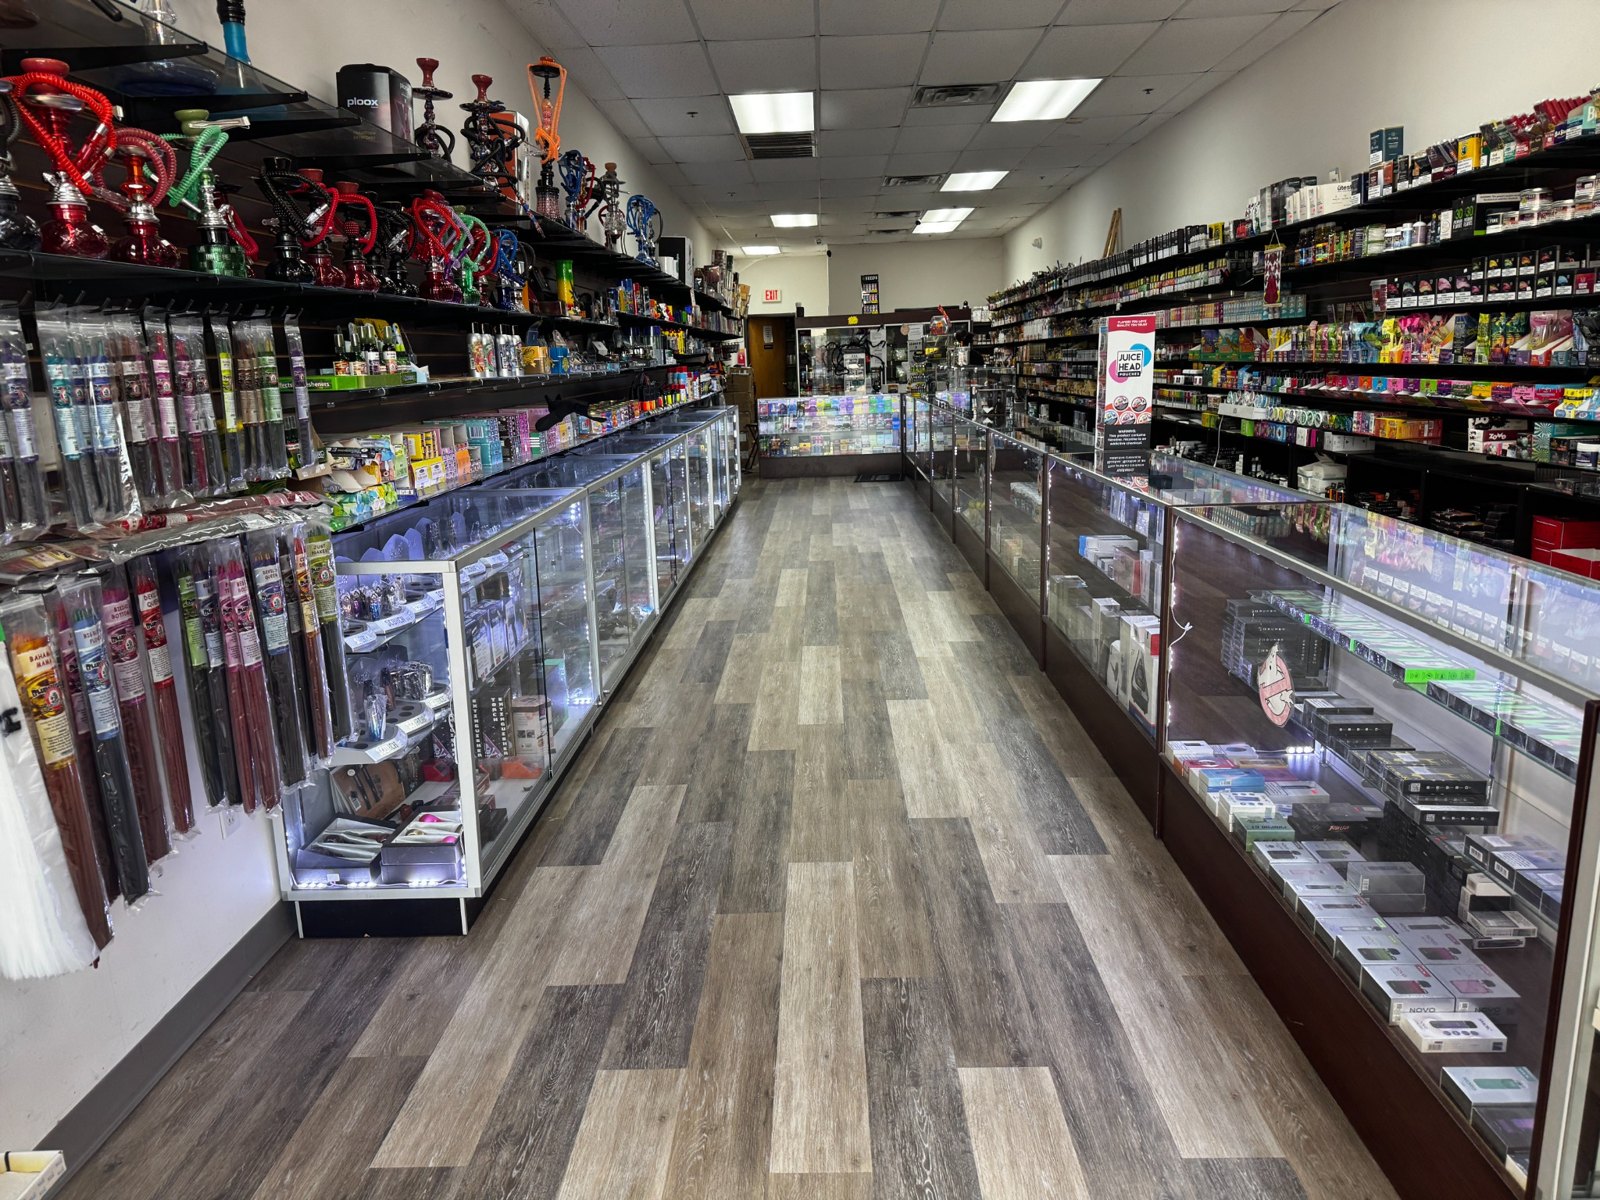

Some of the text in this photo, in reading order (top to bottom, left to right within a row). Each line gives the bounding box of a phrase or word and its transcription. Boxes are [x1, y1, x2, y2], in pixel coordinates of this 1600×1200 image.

[347, 97, 378, 108] ploox
[765, 289, 778, 300] EXIT
[1119, 353, 1141, 361] JUICE
[1119, 362, 1141, 370] HEAD
